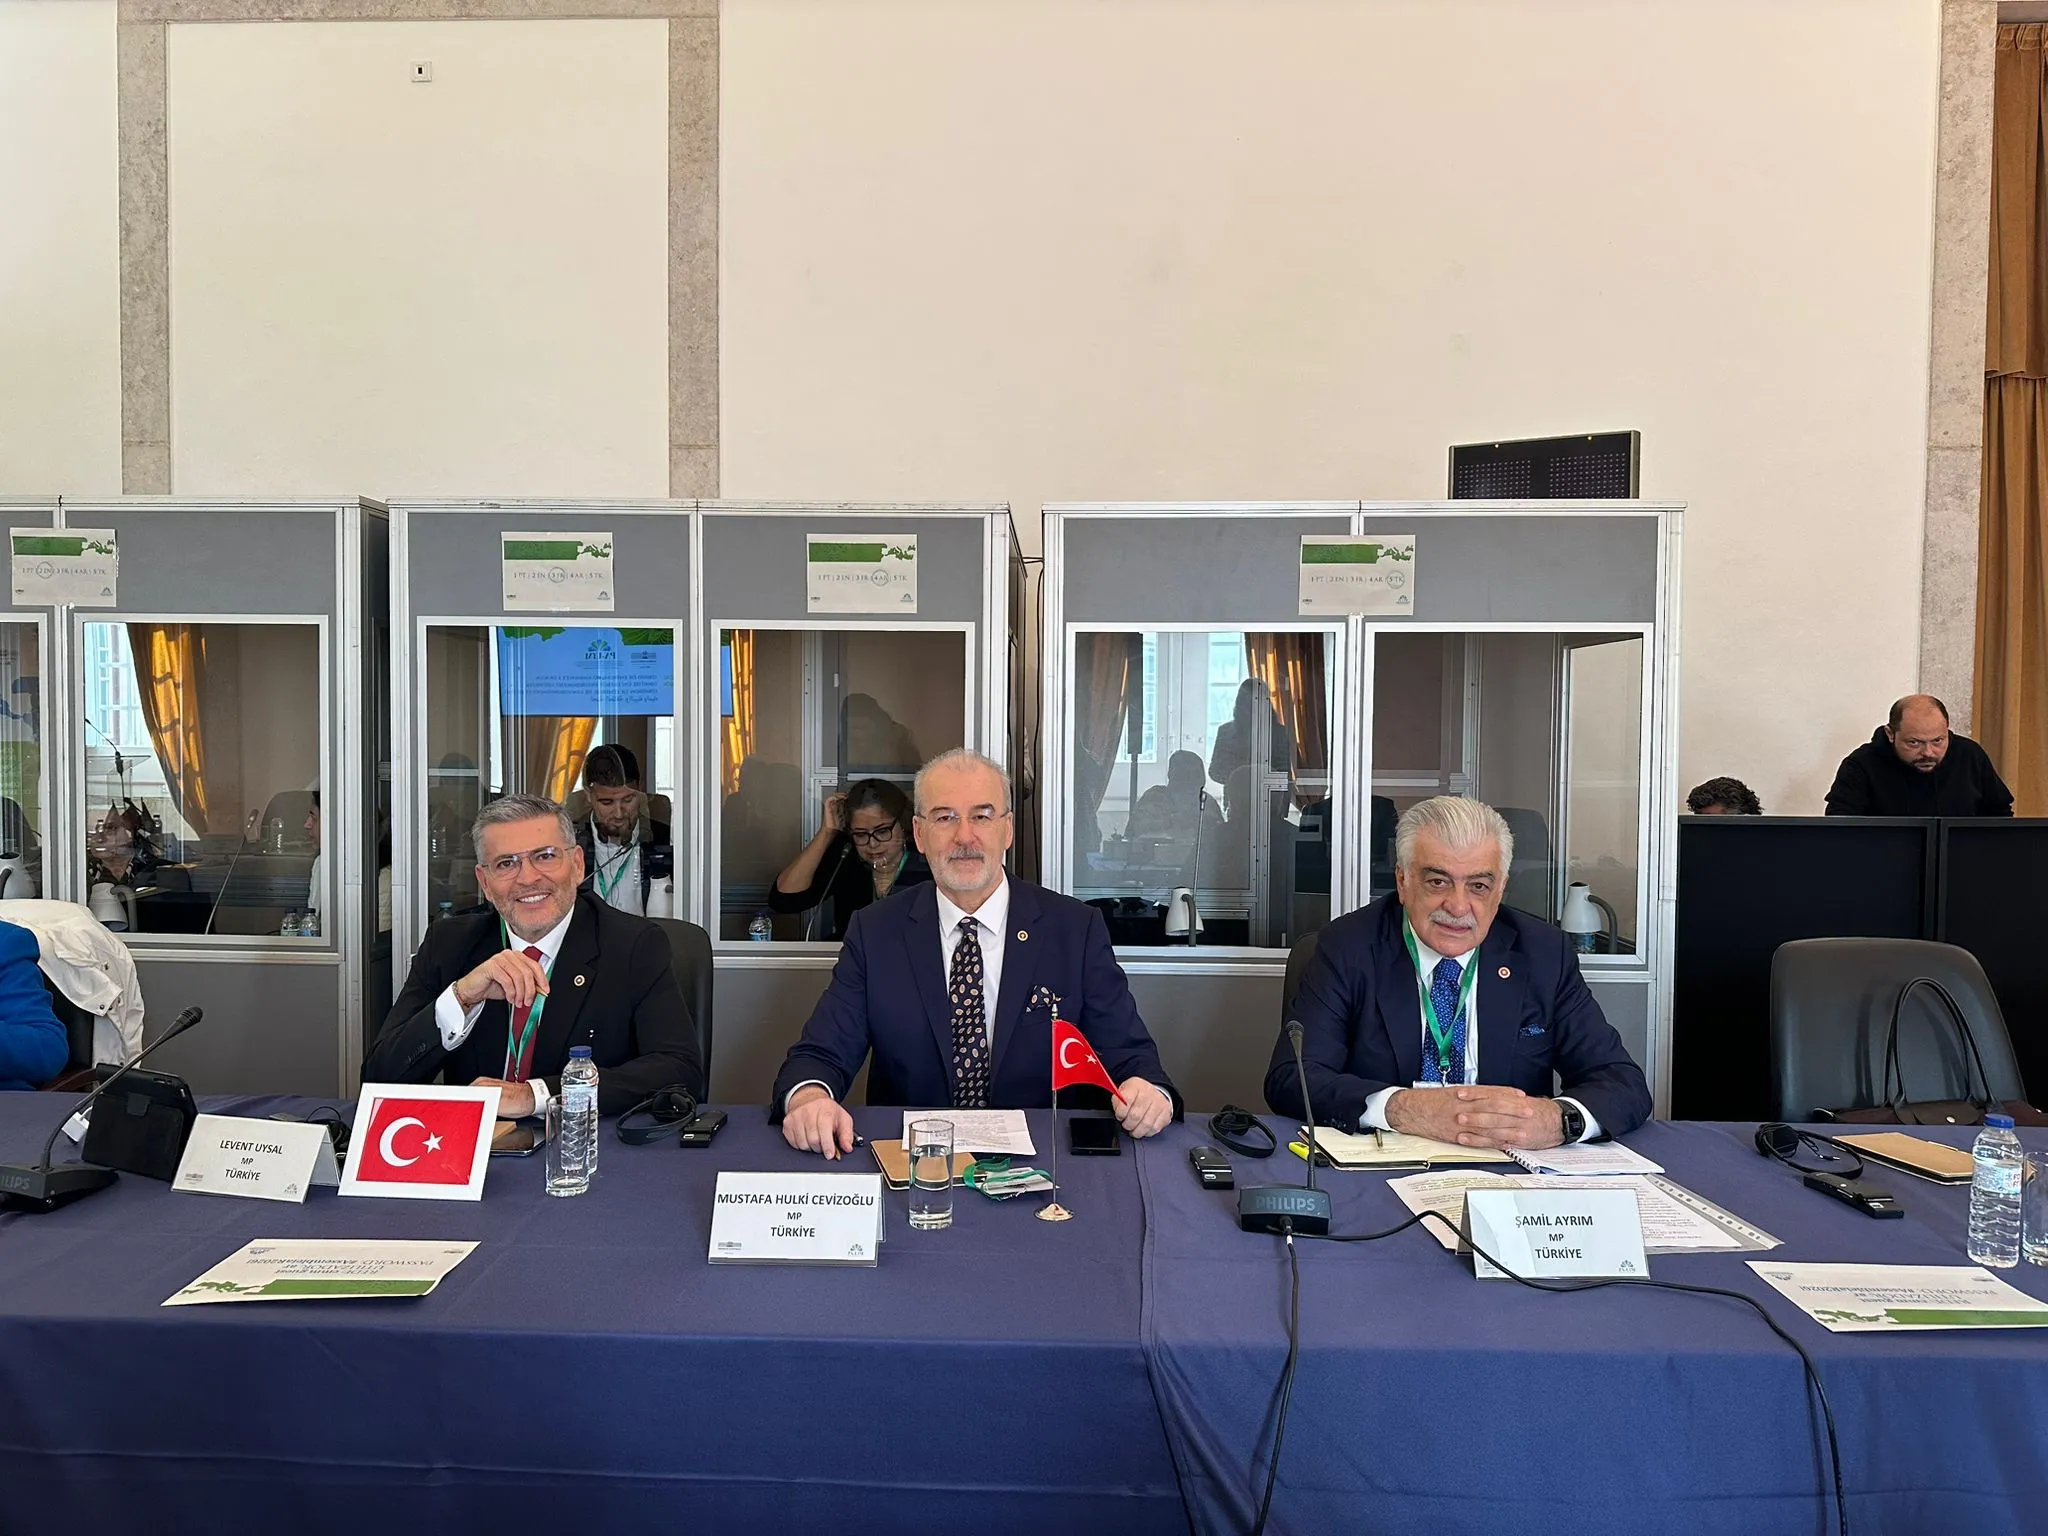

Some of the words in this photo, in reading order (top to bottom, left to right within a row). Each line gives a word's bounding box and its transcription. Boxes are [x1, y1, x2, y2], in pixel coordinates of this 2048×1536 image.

[220, 1140, 253, 1152] LEVENT
[254, 1143, 283, 1155] UYSAL
[240, 1157, 254, 1165] MP
[225, 1168, 261, 1181] TÜRKİYE
[717, 1193, 772, 1204] MUSTAFA
[775, 1192, 809, 1205] HULKİ
[811, 1193, 874, 1206] CEVİZOĞLU
[1256, 1196, 1316, 1211] PHILIPS
[787, 1211, 802, 1220] MP
[1515, 1213, 1552, 1228] ŞAMİL
[1554, 1215, 1593, 1226] AYRIM
[771, 1225, 816, 1238] TÜRKİYE
[1549, 1233, 1564, 1242] MP
[1535, 1246, 1582, 1259] TÜRKİYE
